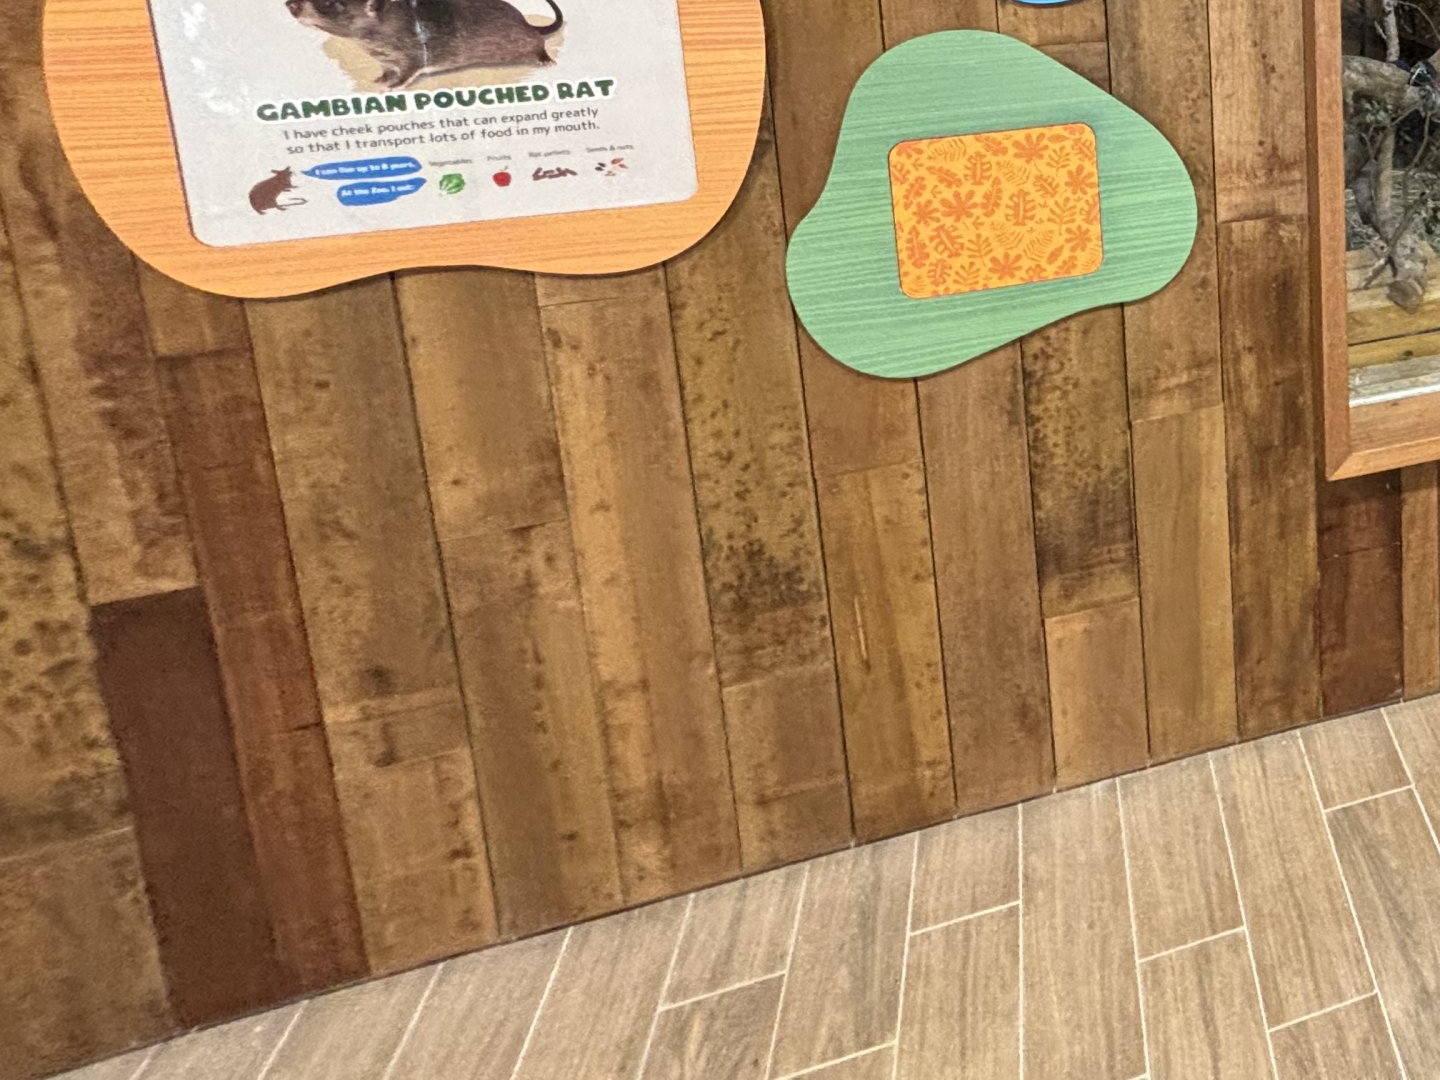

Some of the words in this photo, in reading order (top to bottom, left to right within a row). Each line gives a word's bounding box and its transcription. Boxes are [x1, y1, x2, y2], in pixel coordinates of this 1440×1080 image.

[257, 94, 406, 121] GAMBIAN
[414, 84, 549, 110] POUCHED
[557, 79, 614, 100] RAT
[284, 130, 290, 140] I
[294, 128, 328, 139] have
[332, 124, 373, 137] cheek
[378, 120, 435, 135] pouches
[440, 118, 469, 129] that
[474, 115, 497, 126] can
[502, 110, 548, 126] expand
[552, 107, 598, 124] greatly
[287, 145, 304, 155] so
[308, 141, 340, 153] that
[346, 139, 351, 150] I
[355, 135, 425, 149] transport
[430, 131, 457, 143] lots
[461, 129, 476, 141] of
[481, 126, 512, 139] food
[517, 126, 530, 137] in
[533, 125, 550, 137] my
[555, 120, 600, 133] mouth.
